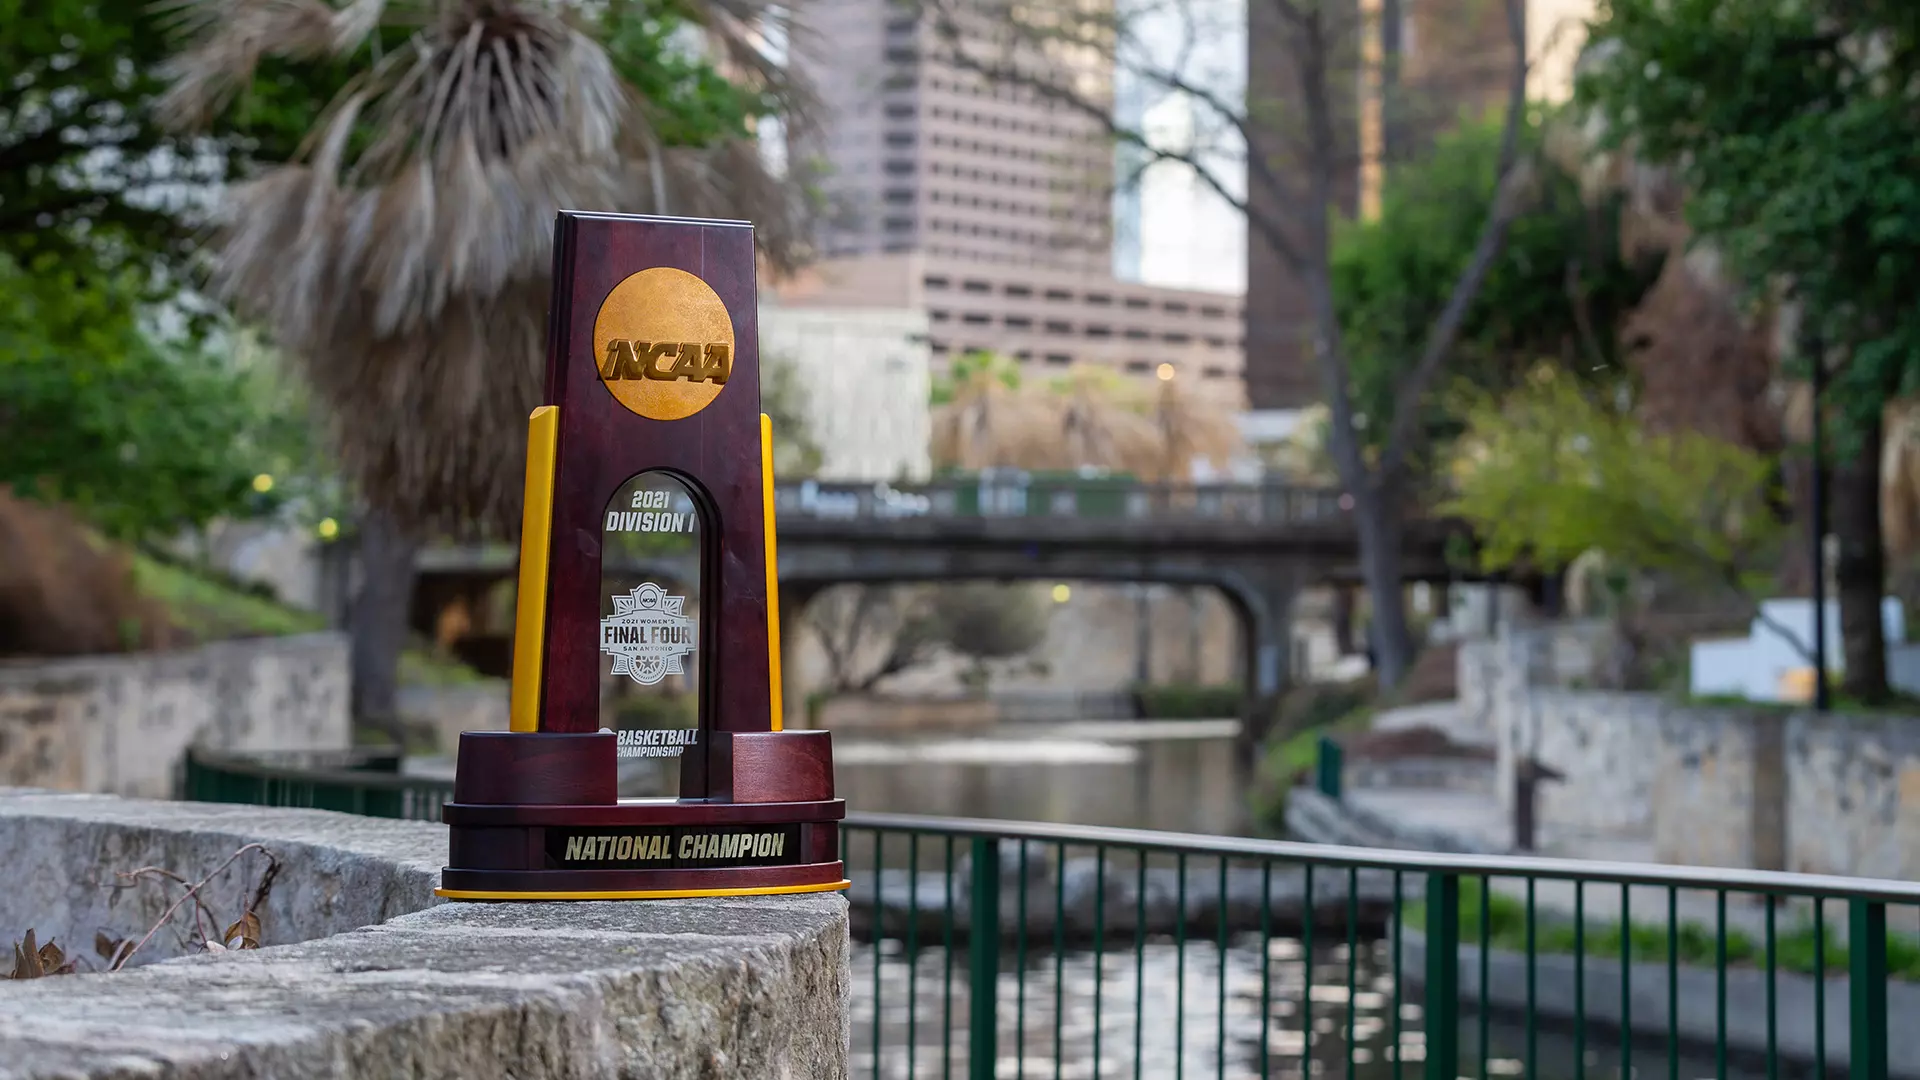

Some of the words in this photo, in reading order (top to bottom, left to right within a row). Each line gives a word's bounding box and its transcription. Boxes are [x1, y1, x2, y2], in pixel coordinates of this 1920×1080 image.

[601, 338, 730, 384] NCAA
[631, 490, 670, 509] 2021
[606, 511, 685, 533] DIVISION
[687, 513, 696, 533] I
[604, 626, 648, 644] FINAL
[650, 626, 692, 644] FOUR
[617, 729, 698, 745] BASKETBALL
[565, 835, 672, 861] NATIONAL
[678, 832, 785, 860] CHAMPION
